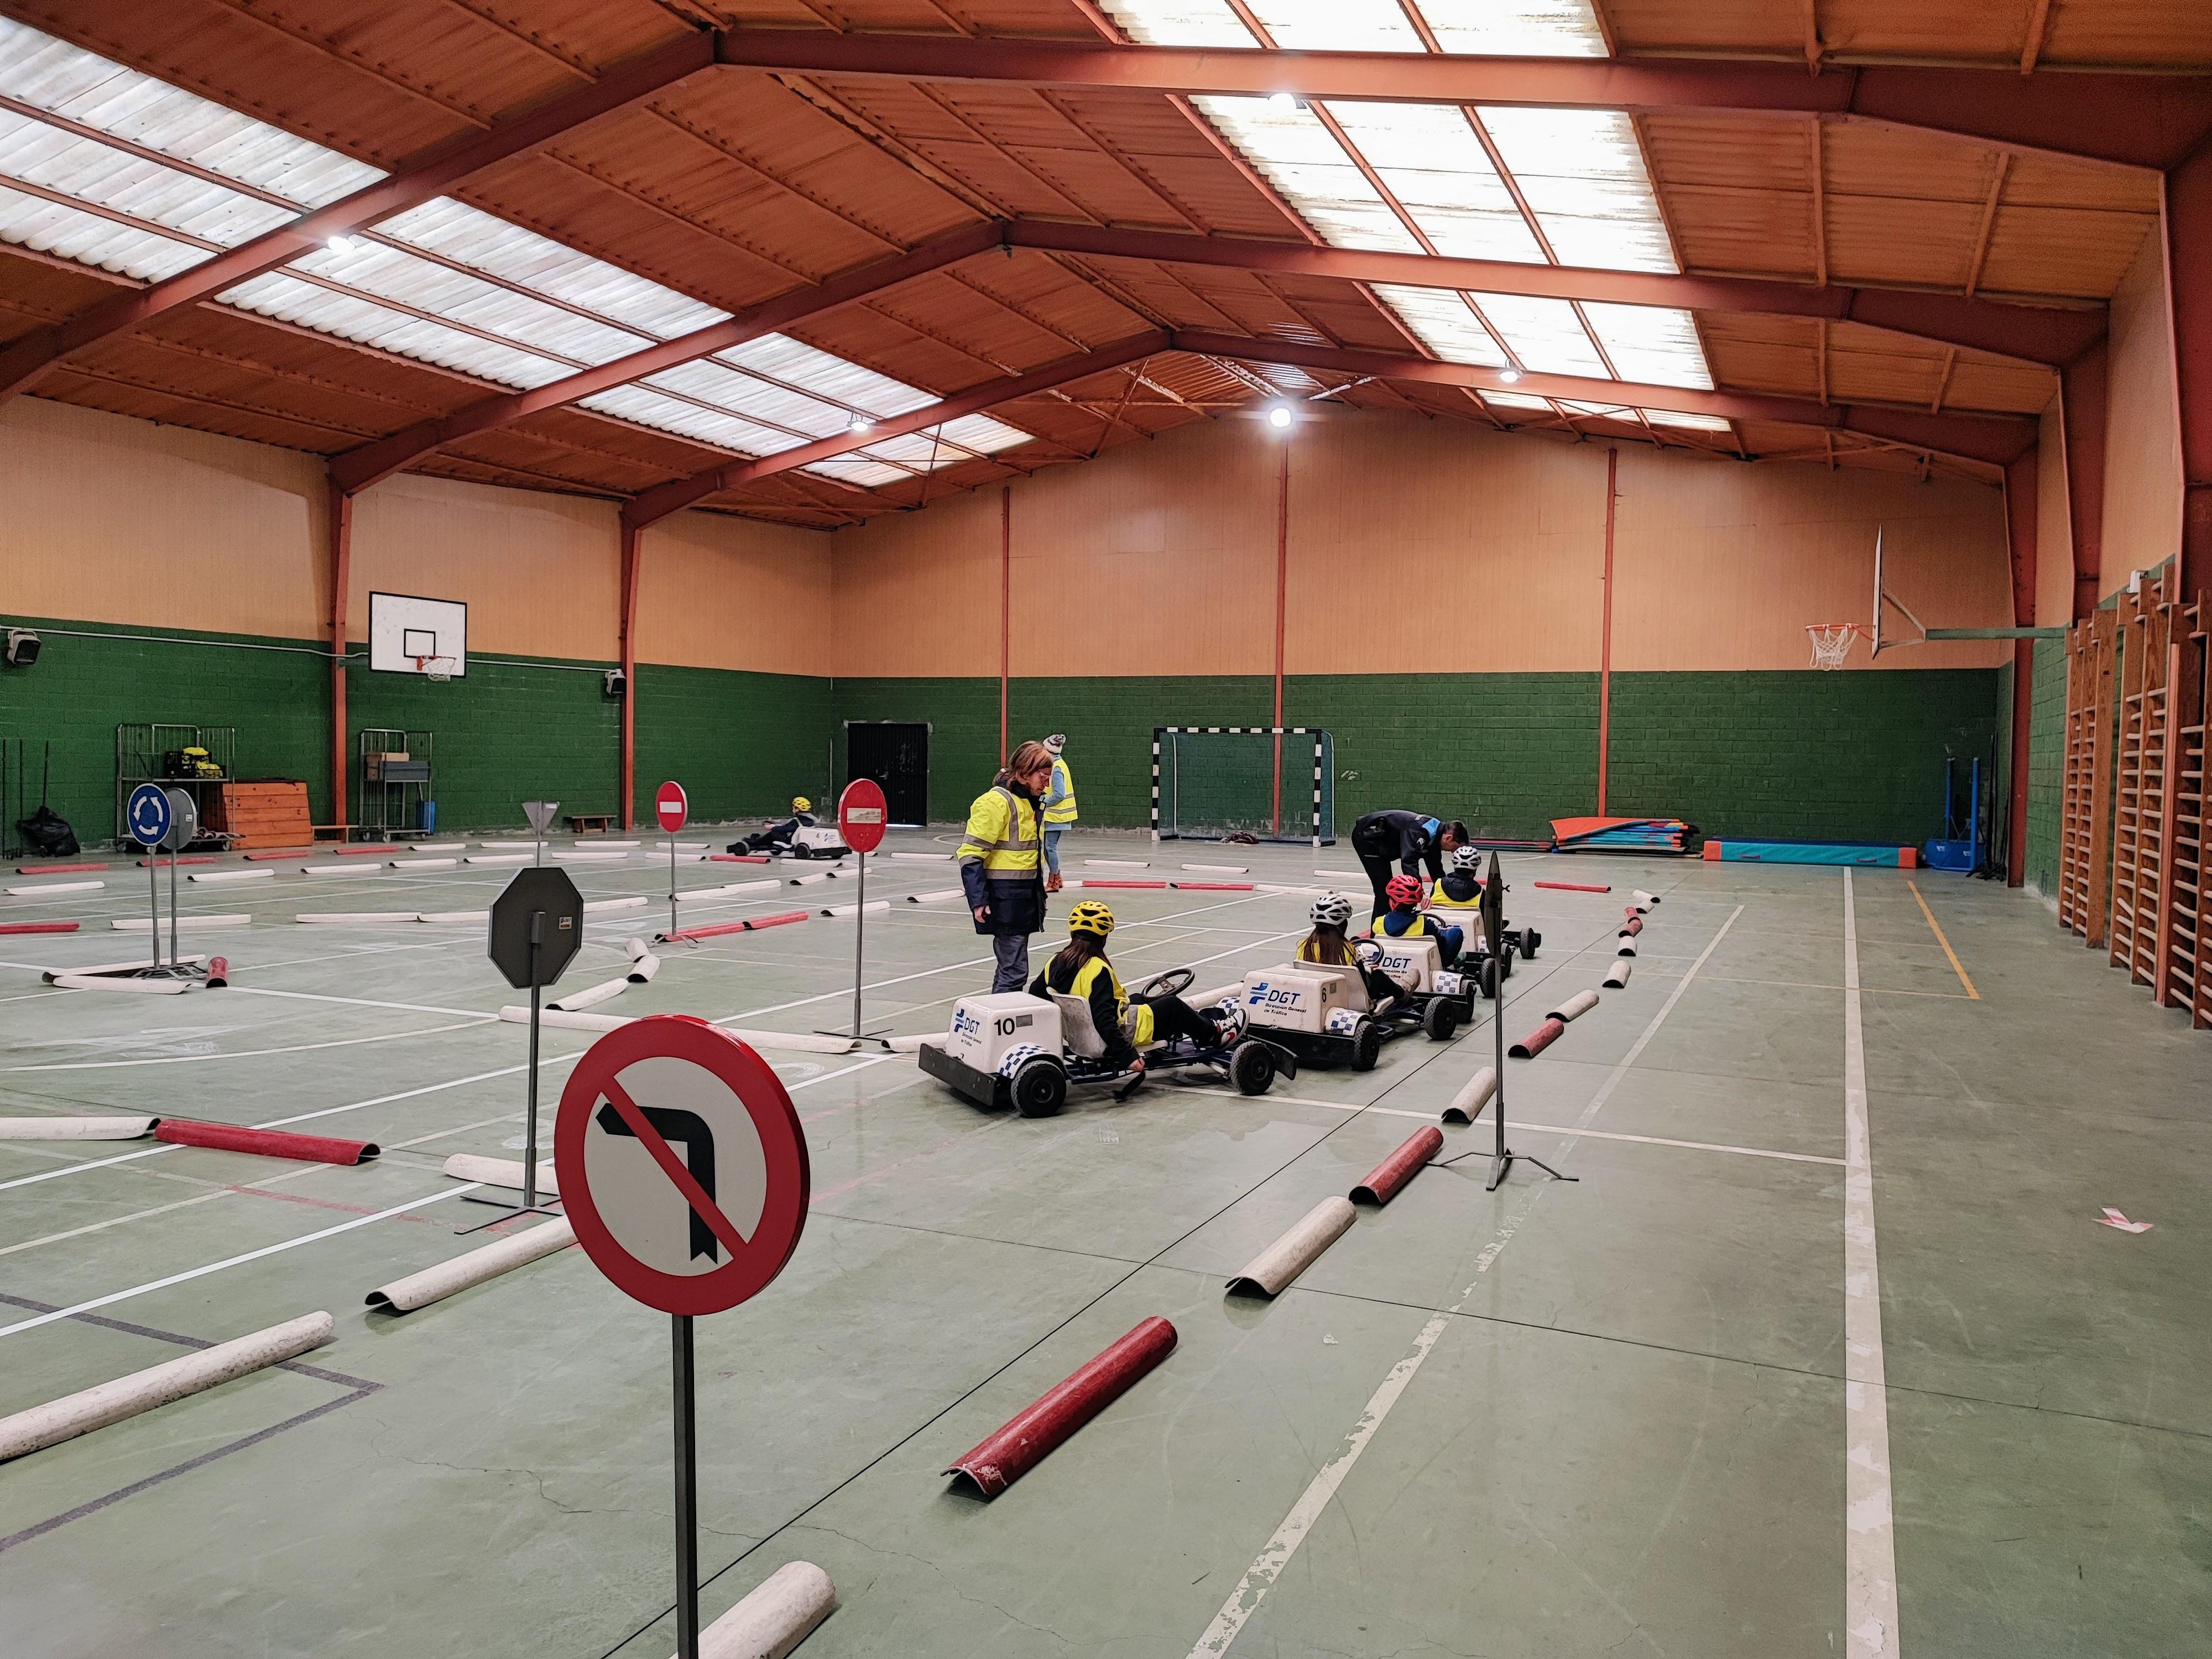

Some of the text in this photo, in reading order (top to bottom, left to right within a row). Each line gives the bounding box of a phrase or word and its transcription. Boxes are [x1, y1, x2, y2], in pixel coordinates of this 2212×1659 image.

[1382, 957, 1411, 968] DGT
[1268, 990, 1301, 1005] DGT
[1322, 987, 1327, 1003] 6
[964, 1017, 980, 1035] DGT
[994, 1018, 1015, 1036] 10
